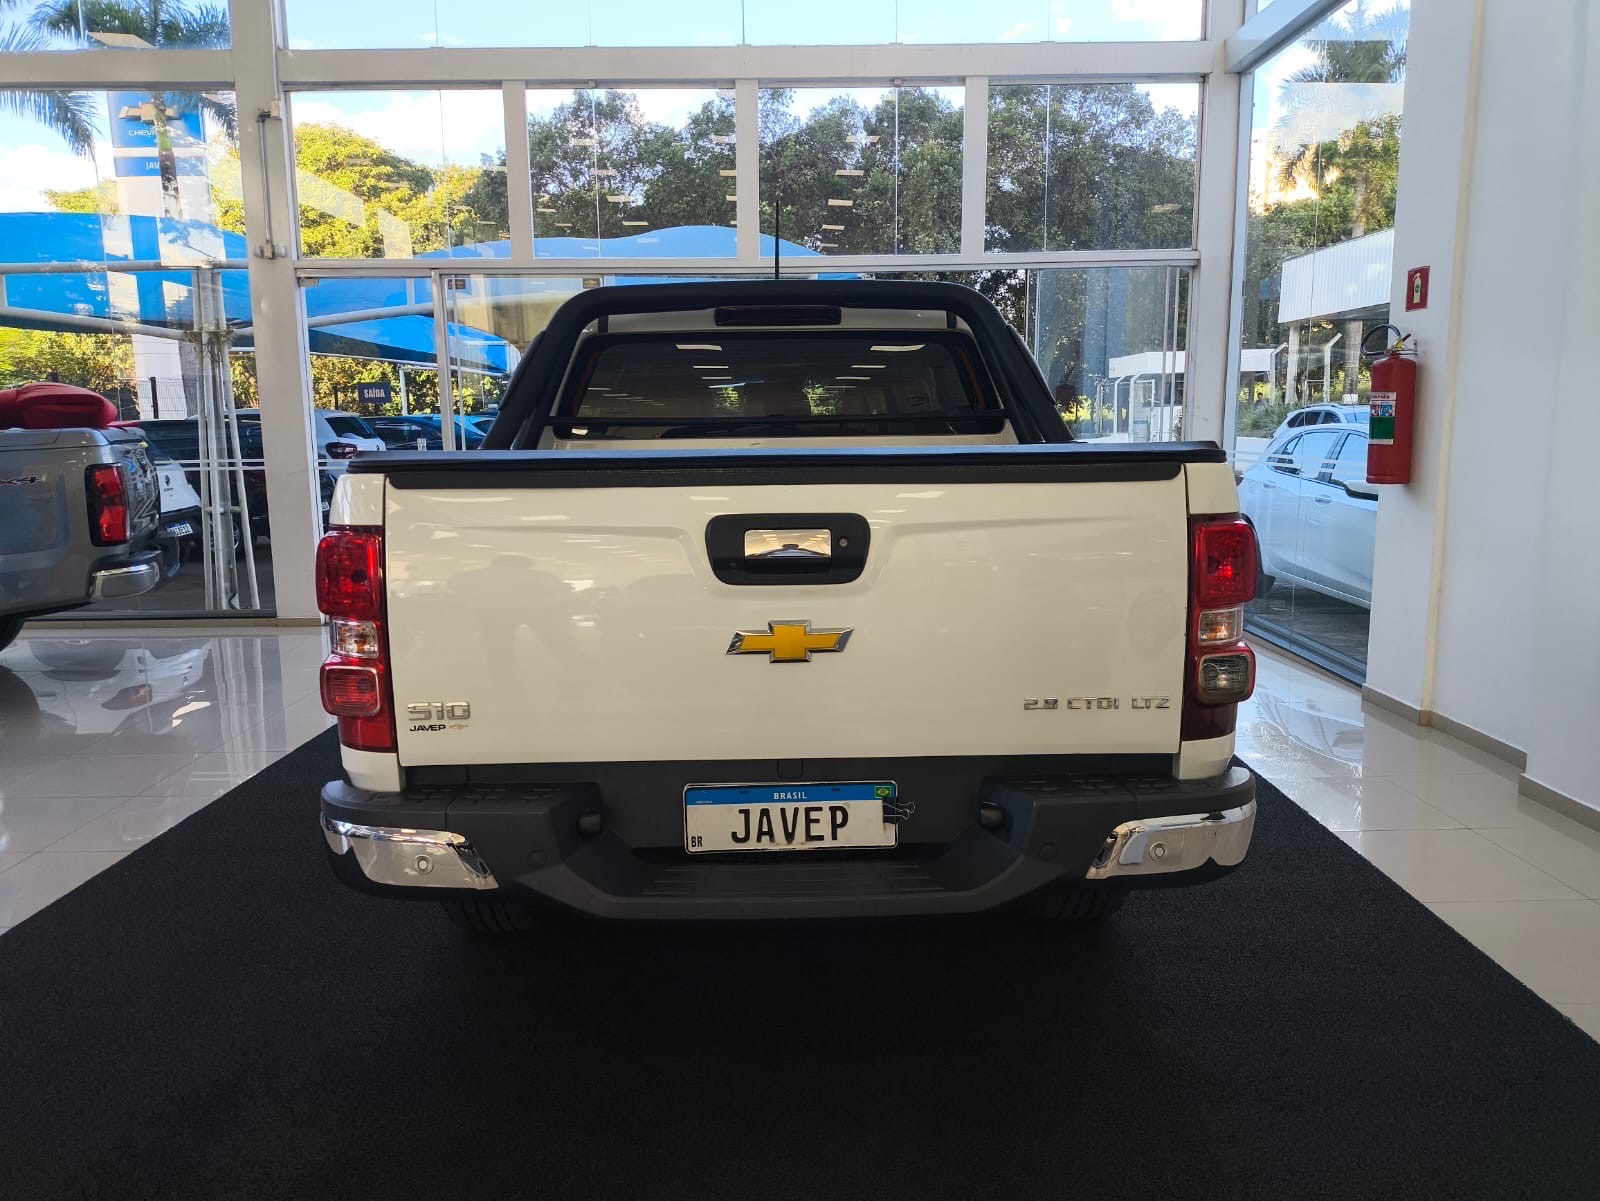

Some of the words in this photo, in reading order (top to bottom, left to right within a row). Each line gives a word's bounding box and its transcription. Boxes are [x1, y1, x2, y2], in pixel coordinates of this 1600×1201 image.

[363, 387, 386, 398] SAÍDA
[1067, 697, 1120, 710] CTDI
[1131, 696, 1171, 710] LTZ
[407, 701, 471, 721] S10
[409, 724, 447, 732] JAVEP
[773, 791, 808, 800] BRASIL
[731, 805, 850, 845] JAVEP
[690, 836, 704, 848] BR
